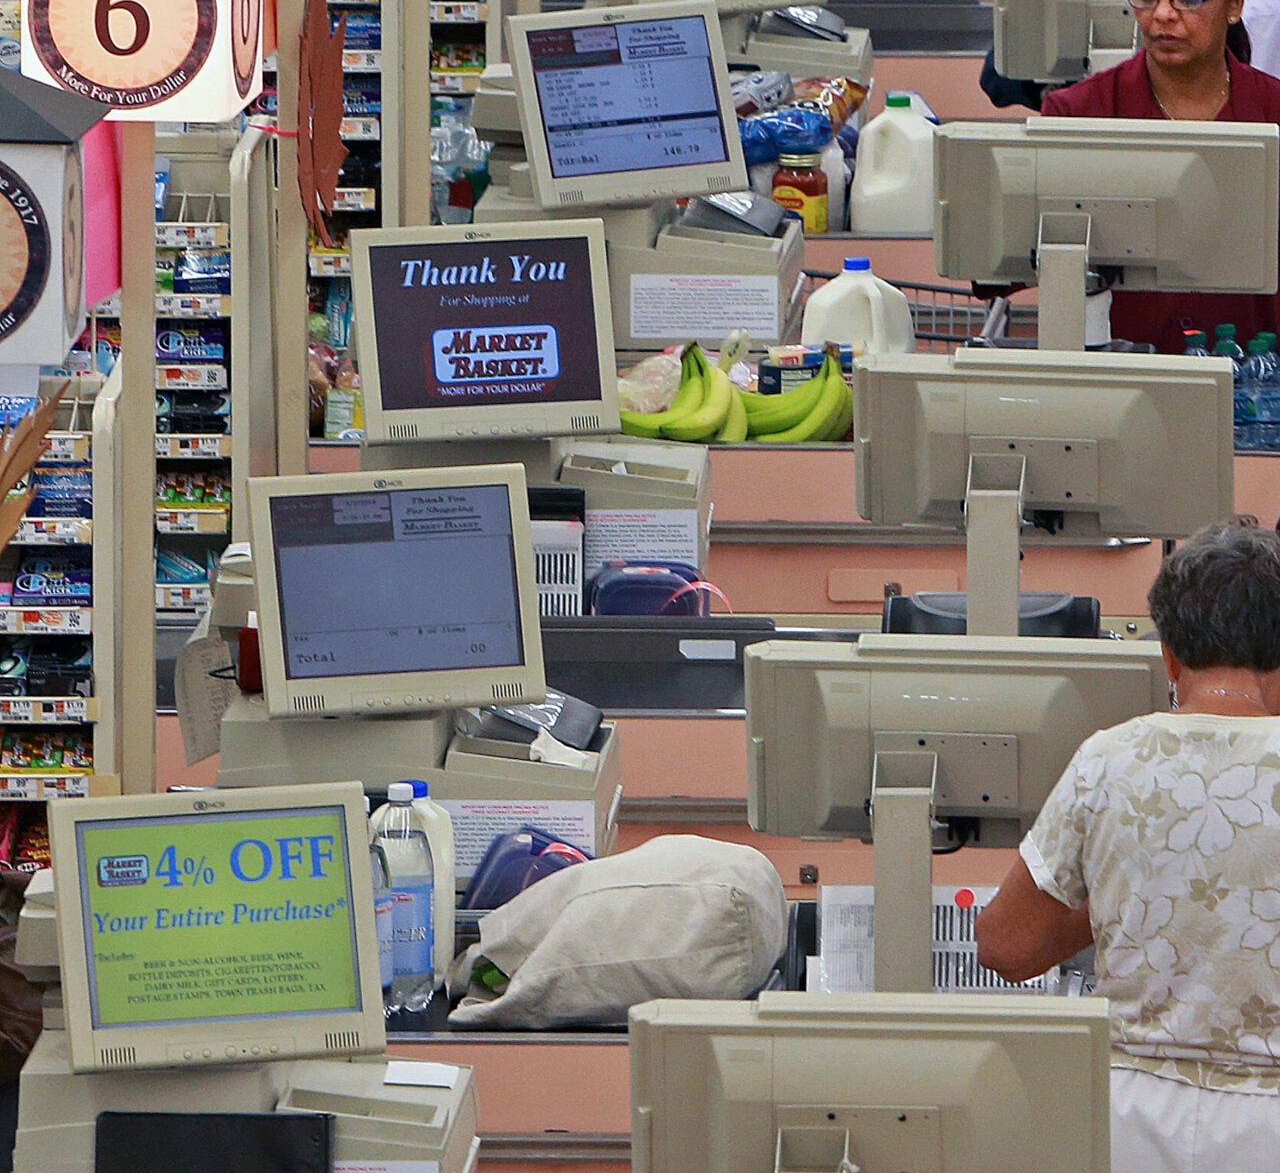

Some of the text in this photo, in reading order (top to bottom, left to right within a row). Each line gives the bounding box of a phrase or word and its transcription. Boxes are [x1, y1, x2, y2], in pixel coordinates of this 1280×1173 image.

[56, 64, 188, 105] More For Your Dollar
[10, 185, 39, 226] 1917
[400, 254, 567, 288] Thank You
[463, 294, 516, 309] Shopping
[442, 331, 548, 355] MARKET
[449, 355, 545, 379] BASKET
[467, 385, 484, 396] FOR
[485, 384, 510, 394] YOUR
[426, 505, 475, 516] Shopping
[296, 643, 487, 664] Total .00
[103, 859, 143, 869] MARKET
[155, 834, 334, 887] 4% OFF
[93, 911, 149, 934] Your
[155, 906, 225, 931] Entire
